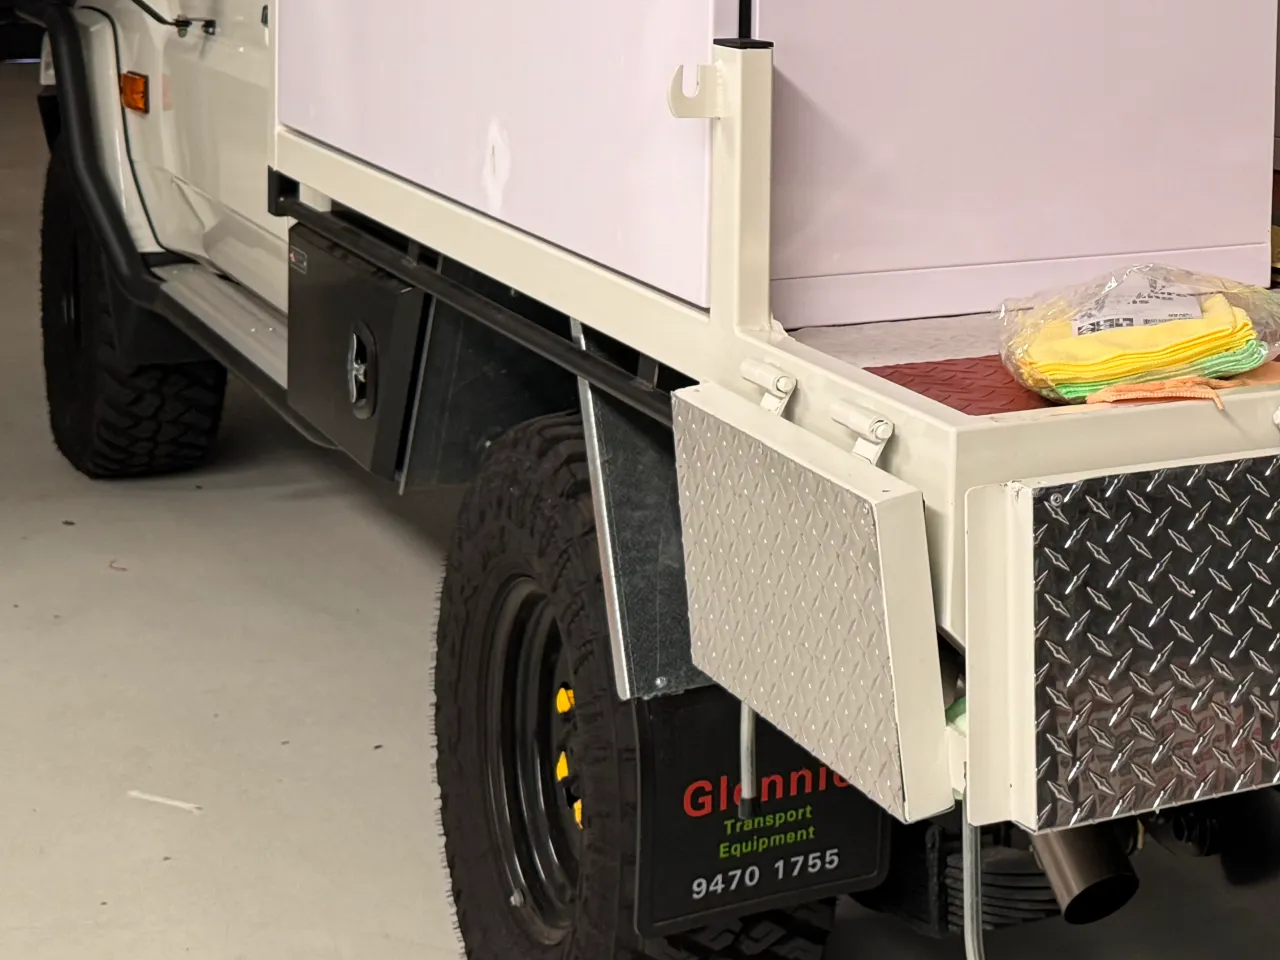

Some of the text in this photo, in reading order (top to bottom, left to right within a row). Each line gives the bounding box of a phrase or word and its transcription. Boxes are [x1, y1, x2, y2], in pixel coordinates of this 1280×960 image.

[724, 804, 812, 835] Transport
[719, 826, 815, 858] Equipment
[691, 848, 840, 900] 9470 1755
